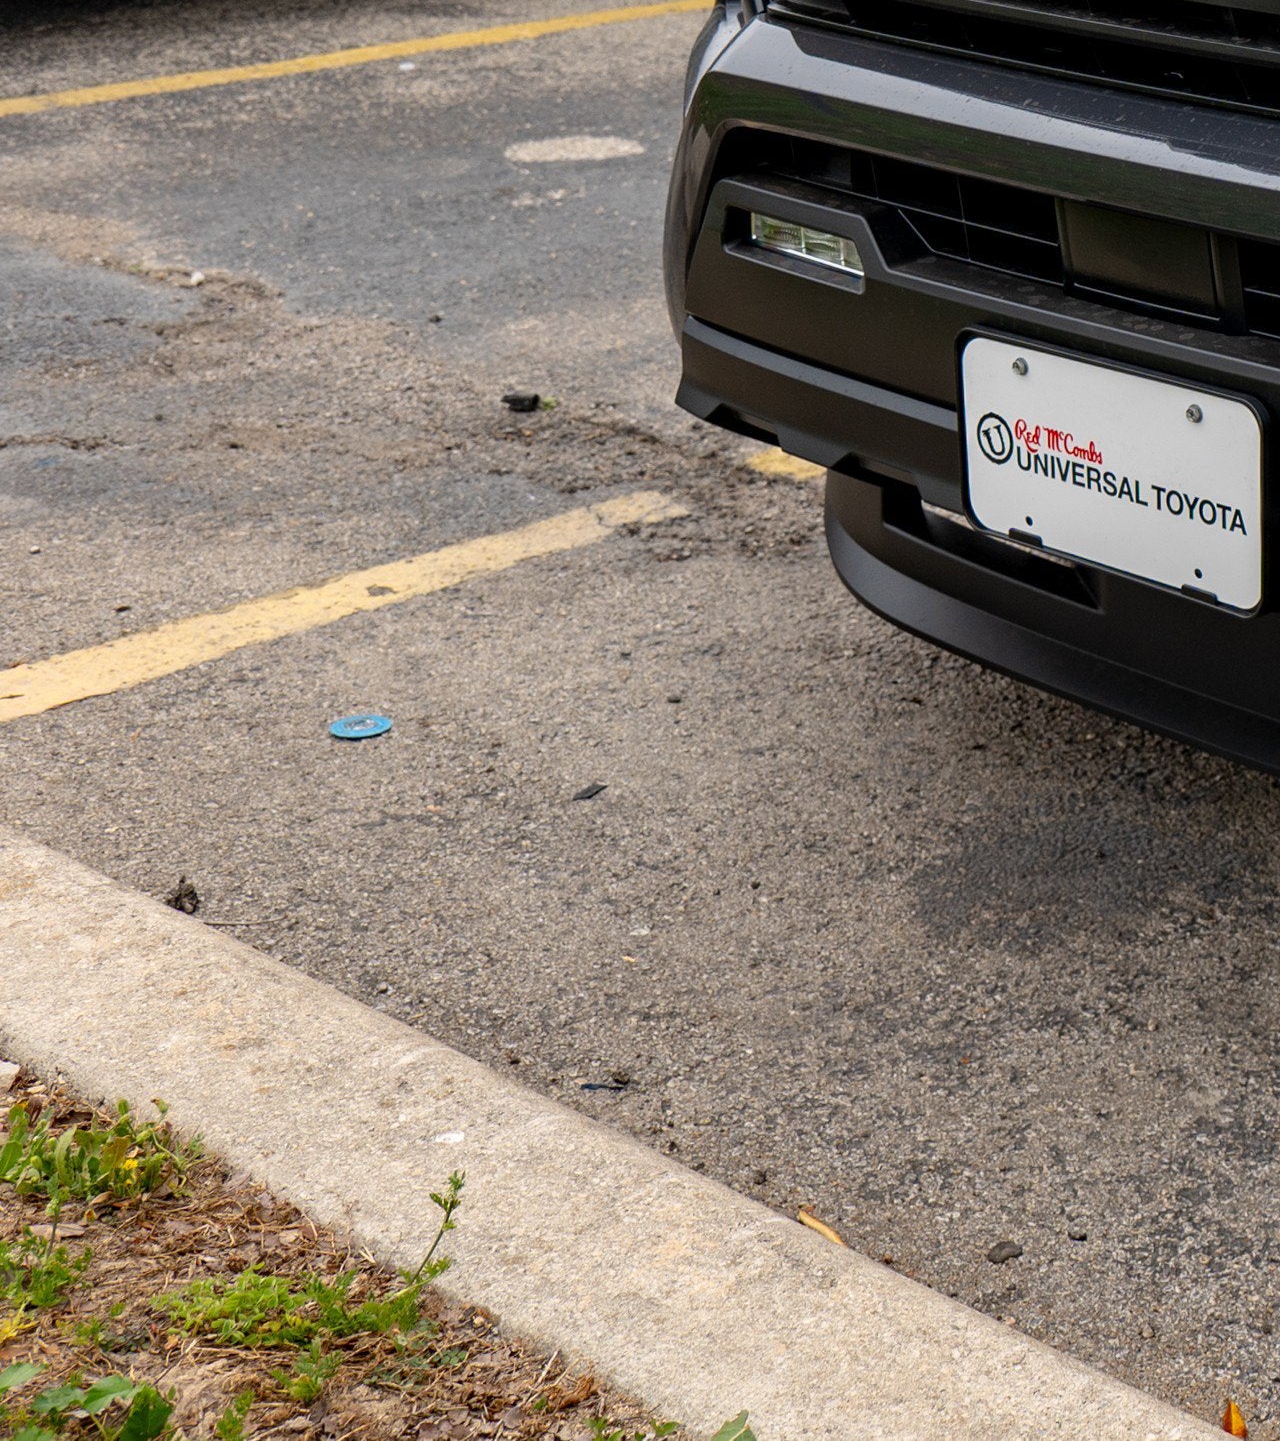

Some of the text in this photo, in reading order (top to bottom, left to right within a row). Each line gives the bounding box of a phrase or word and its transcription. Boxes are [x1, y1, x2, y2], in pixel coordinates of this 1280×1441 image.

[1014, 419, 1103, 465] Red McCombs
[1016, 445, 1247, 536] UNIVERSAL TOYOTA
